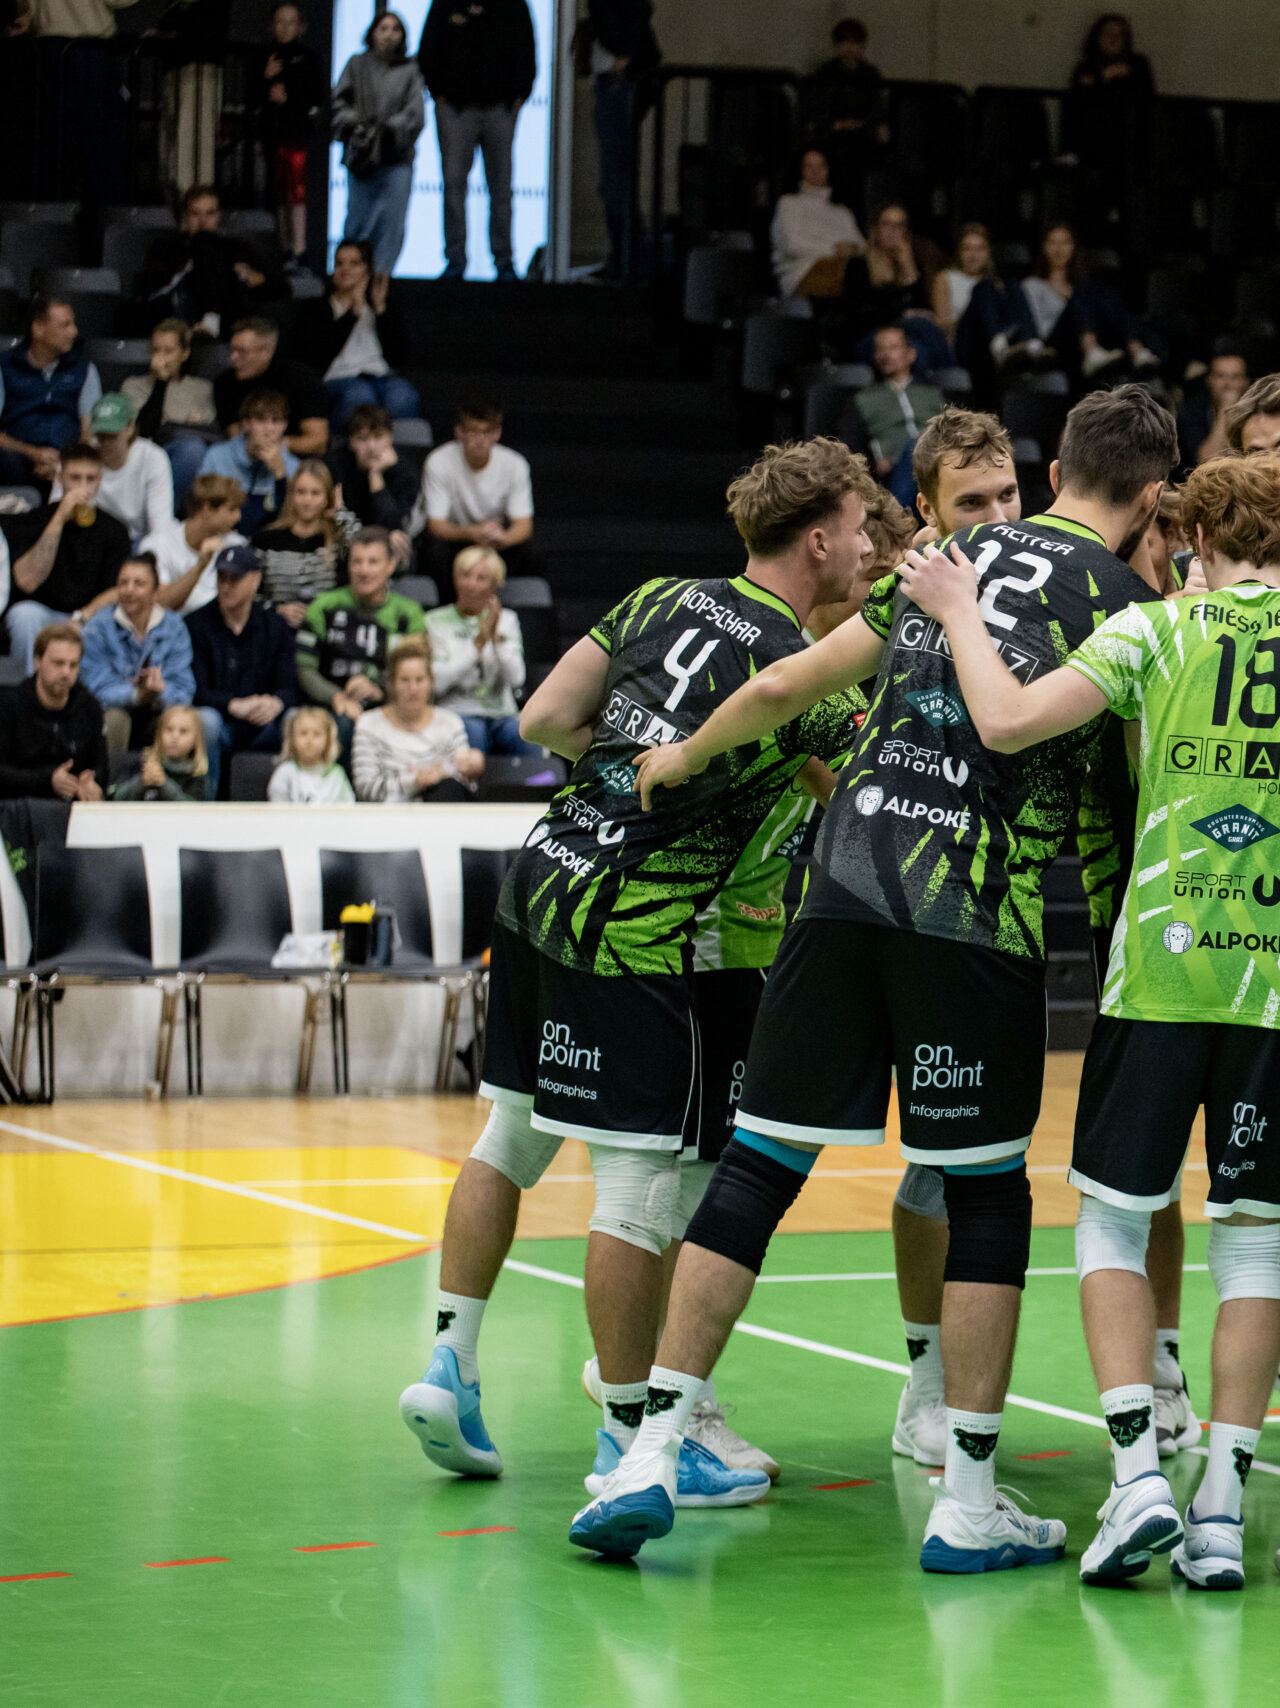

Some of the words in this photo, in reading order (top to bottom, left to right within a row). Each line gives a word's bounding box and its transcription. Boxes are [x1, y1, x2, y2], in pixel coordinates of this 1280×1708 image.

[973, 539, 1053, 632] 12
[677, 588, 762, 647] KOPSCHAR
[663, 628, 721, 713] 4
[919, 699, 959, 723] GRANIT
[881, 740, 941, 764] SPORT
[882, 795, 972, 831] ALPOKE
[1211, 822, 1260, 840] GRANIT
[538, 837, 596, 878] ALPOKE
[1175, 871, 1247, 887] SPORT
[1174, 885, 1246, 901] union
[543, 1019, 571, 1045] on
[538, 1039, 602, 1072] point
[914, 1043, 953, 1066] on
[912, 1060, 984, 1091] point
[909, 1102, 980, 1120] infographics
